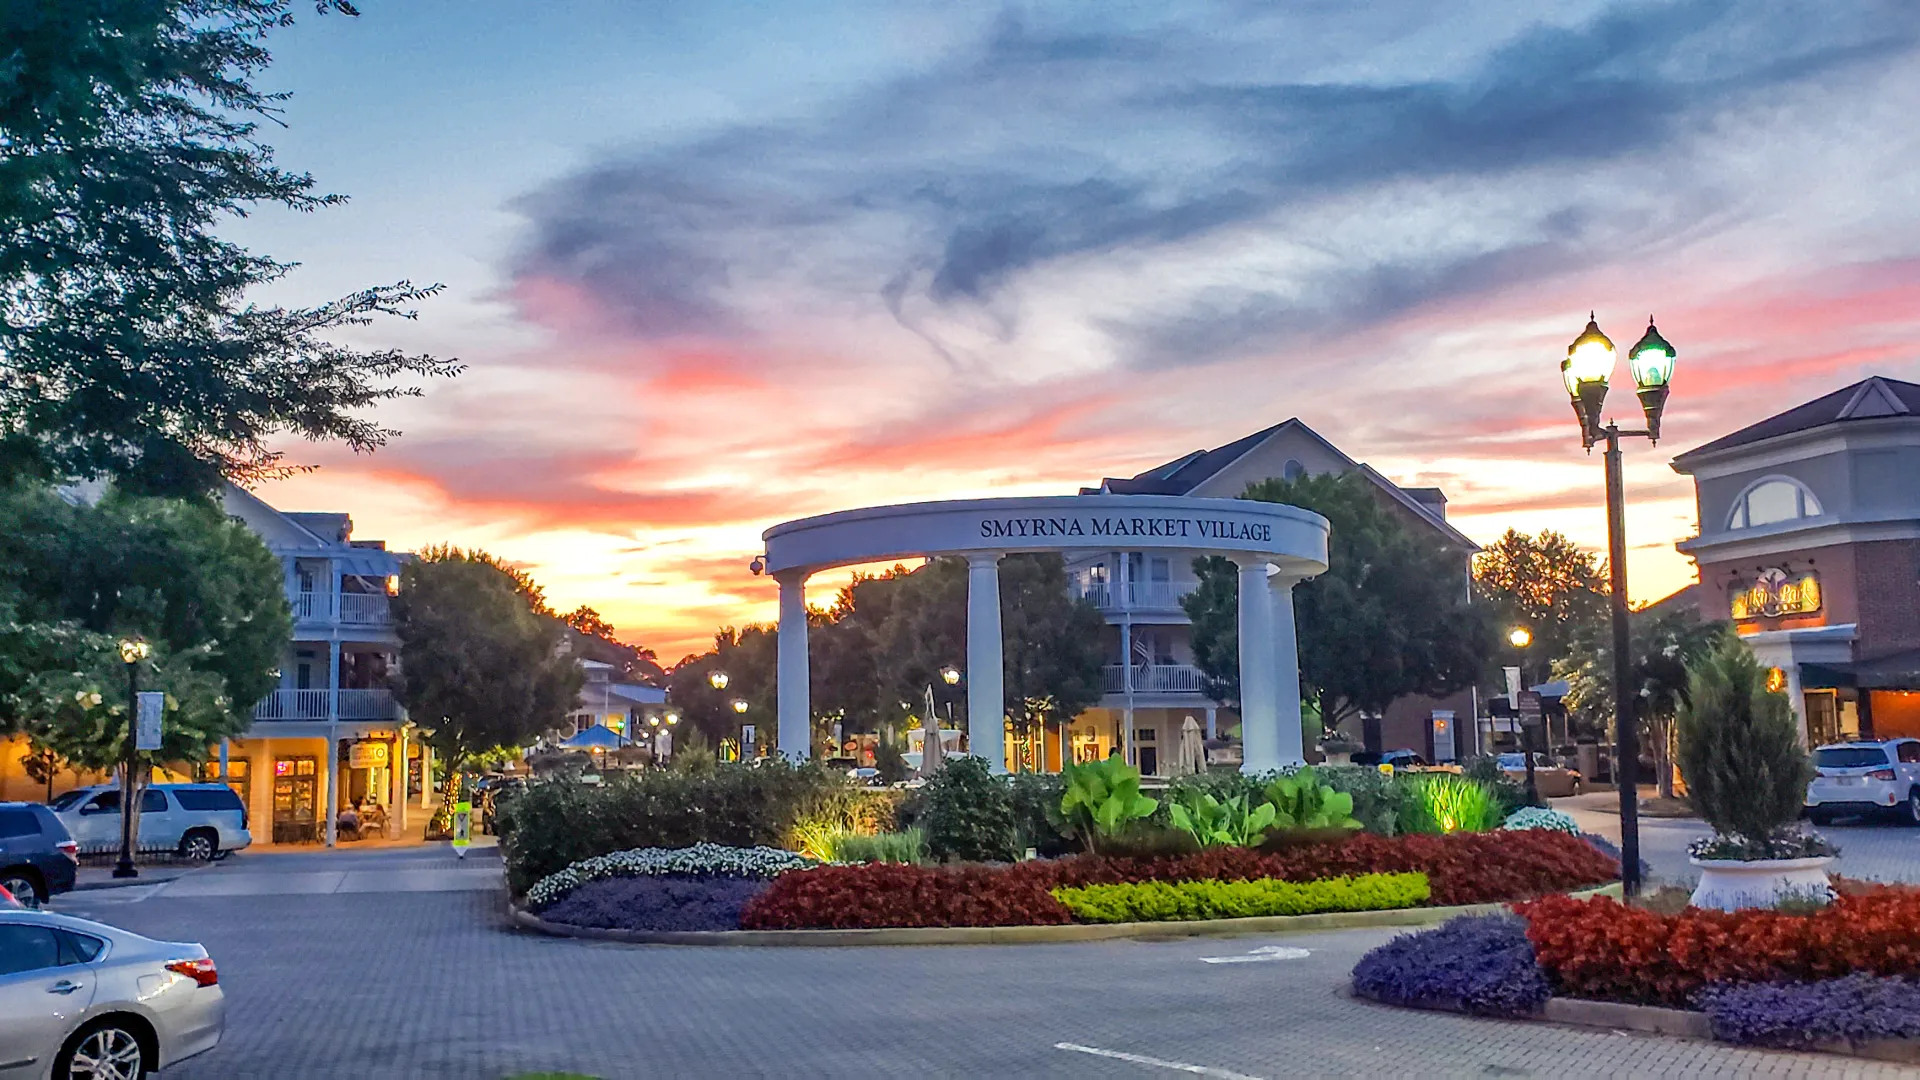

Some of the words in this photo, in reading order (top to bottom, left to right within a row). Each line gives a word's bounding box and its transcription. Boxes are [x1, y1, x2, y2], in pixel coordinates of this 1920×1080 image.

[981, 518, 1085, 538] SMYRNA
[1092, 518, 1191, 537] MARKET
[1196, 520, 1271, 541] VILLAGE
